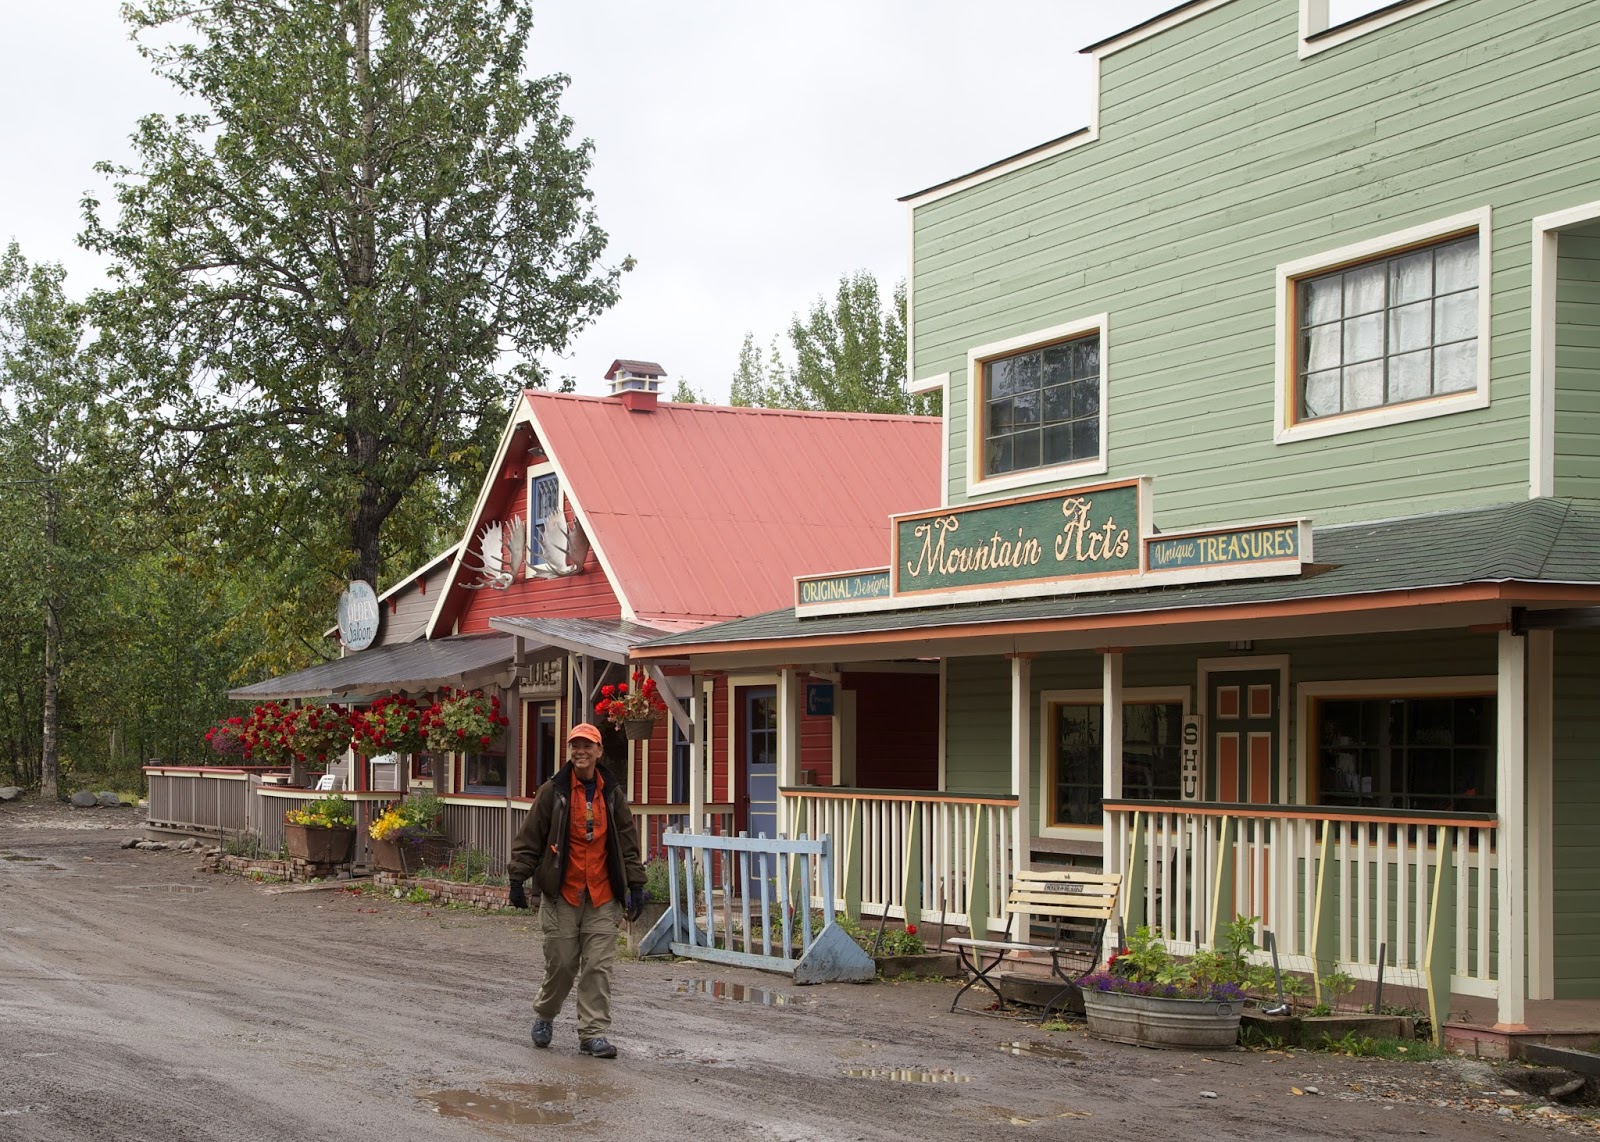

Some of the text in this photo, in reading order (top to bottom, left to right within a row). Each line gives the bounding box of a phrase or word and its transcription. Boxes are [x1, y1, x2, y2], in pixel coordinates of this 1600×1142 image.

[907, 497, 1130, 578] Mountain Arts
[1155, 529, 1294, 565] Unique TREASURES
[802, 575, 889, 602] ORIGINAL Designs
[347, 622, 372, 644] Saloon
